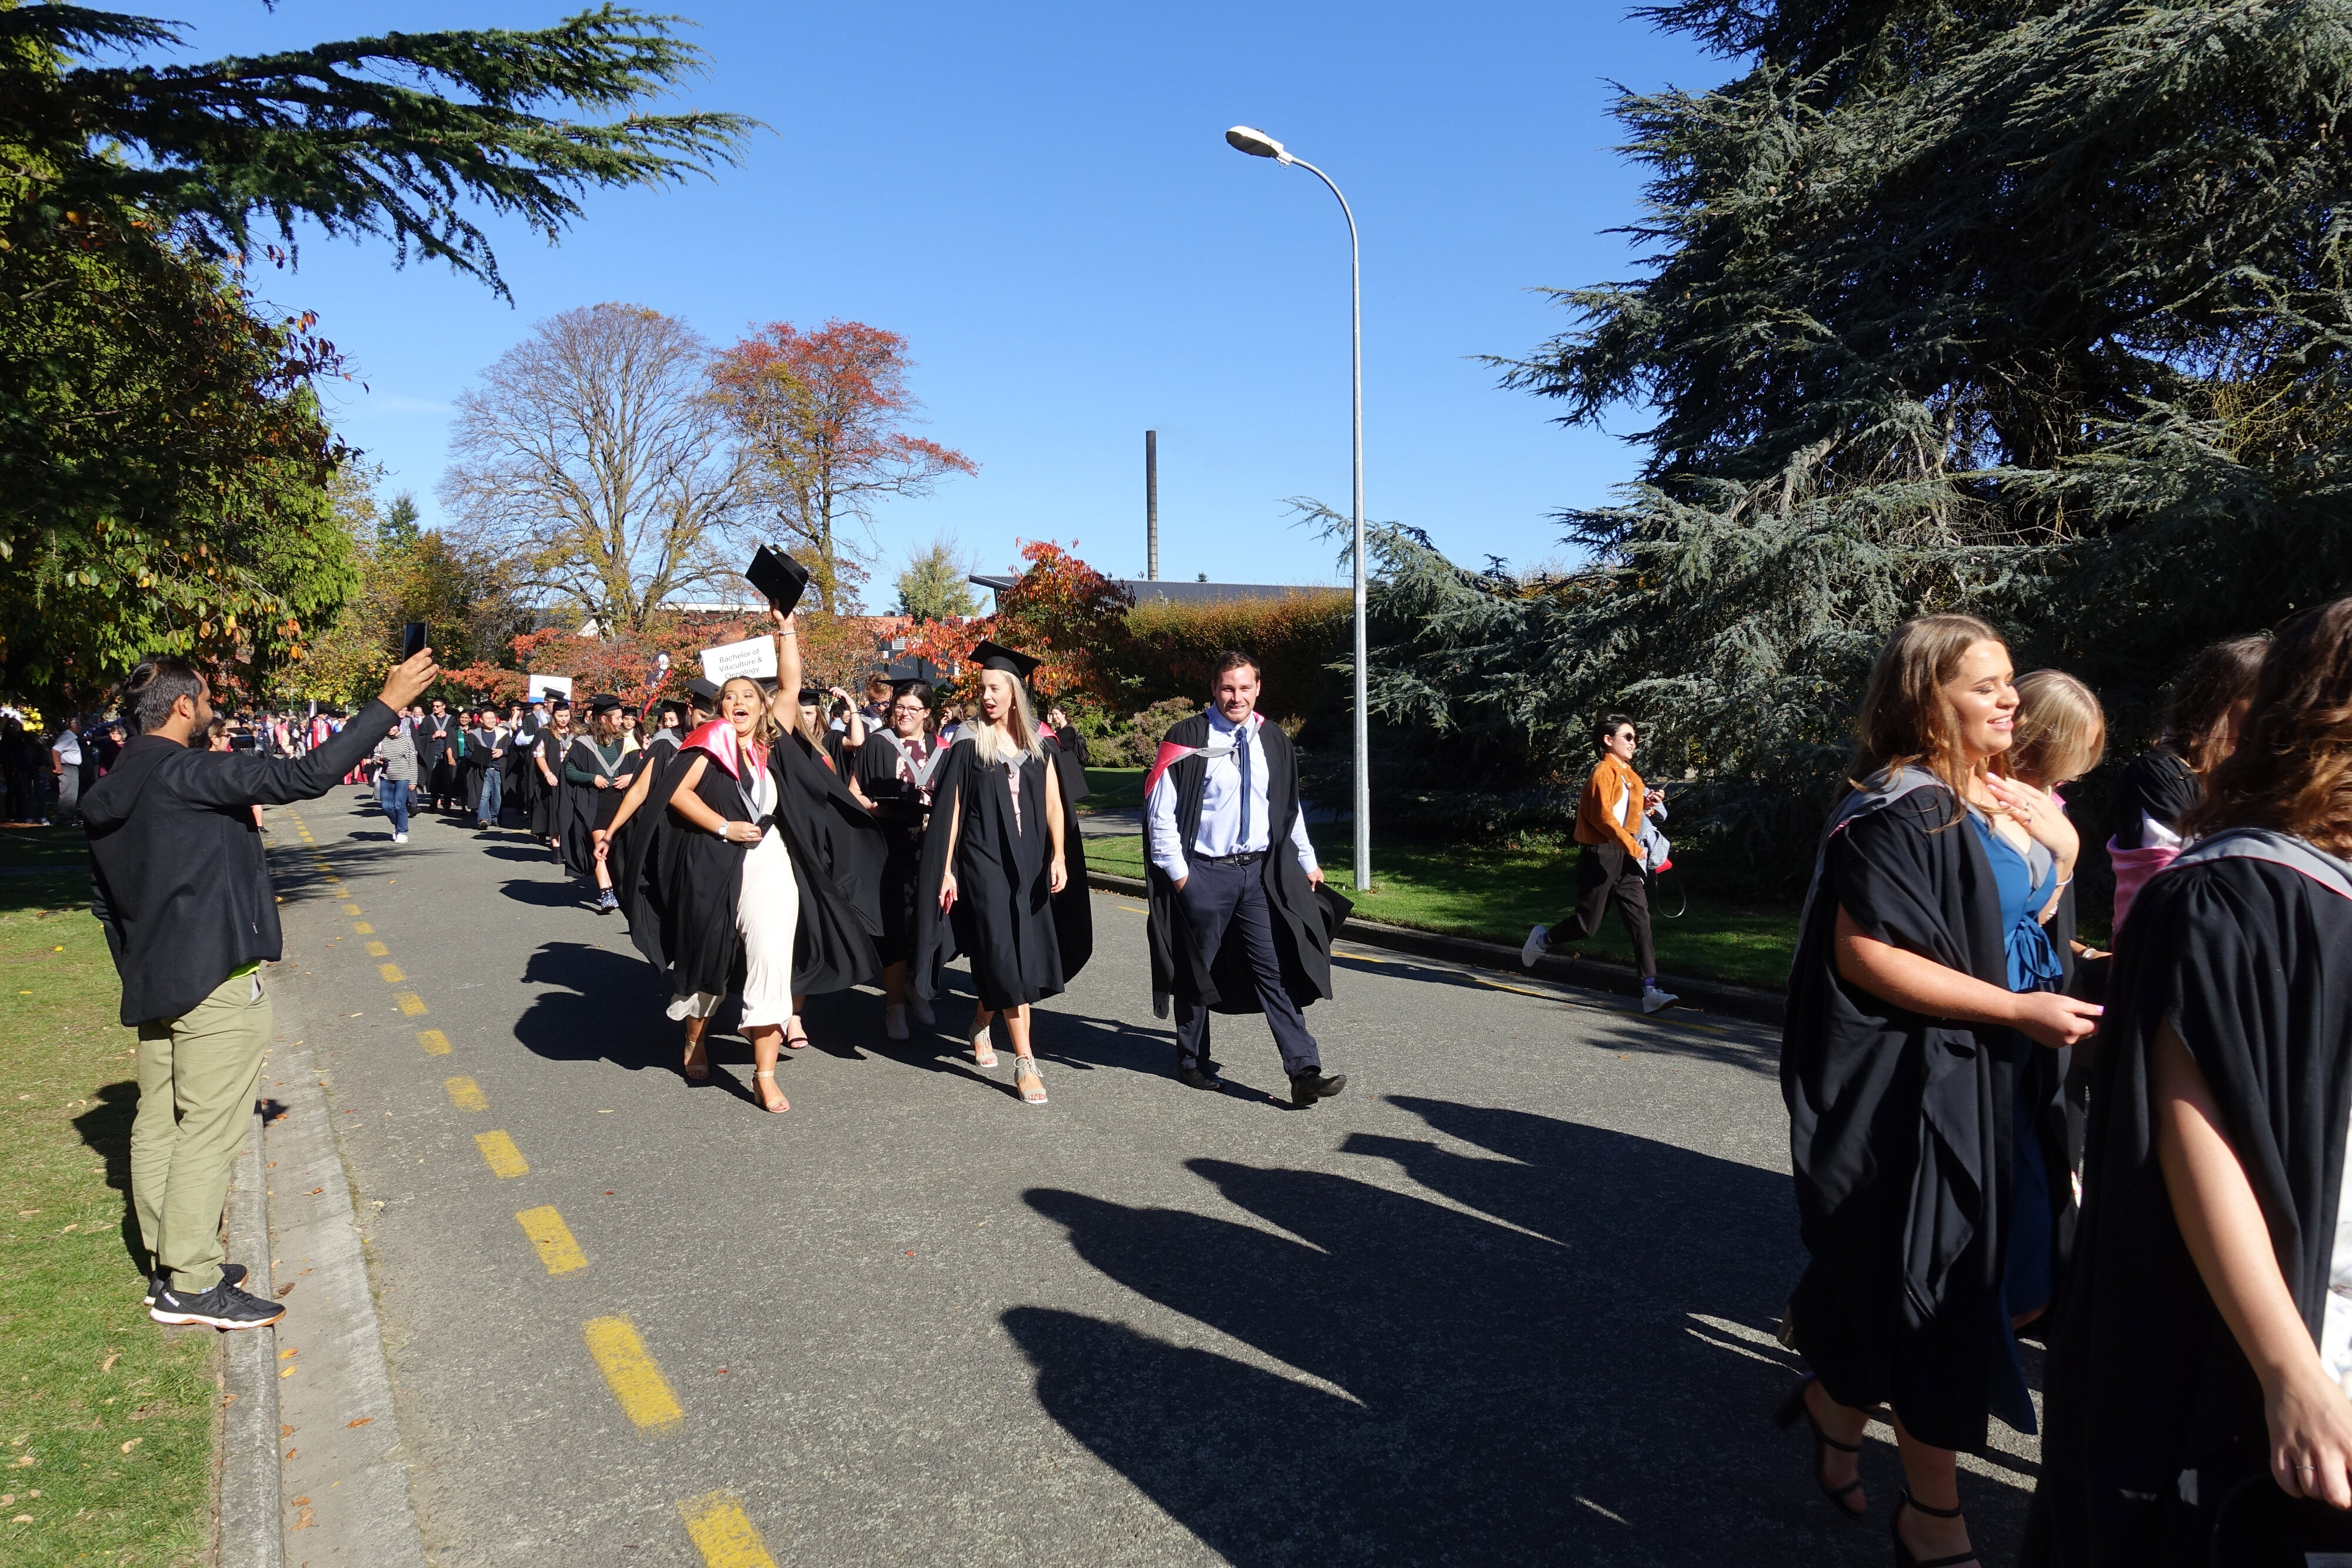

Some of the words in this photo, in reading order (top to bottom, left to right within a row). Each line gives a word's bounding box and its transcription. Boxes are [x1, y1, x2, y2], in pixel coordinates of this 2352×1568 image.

[719, 652, 750, 663] Bachelor
[719, 659, 756, 672] Viticulture
[725, 667, 759, 679] Oenology
[164, 1292, 181, 1307] Reebok
